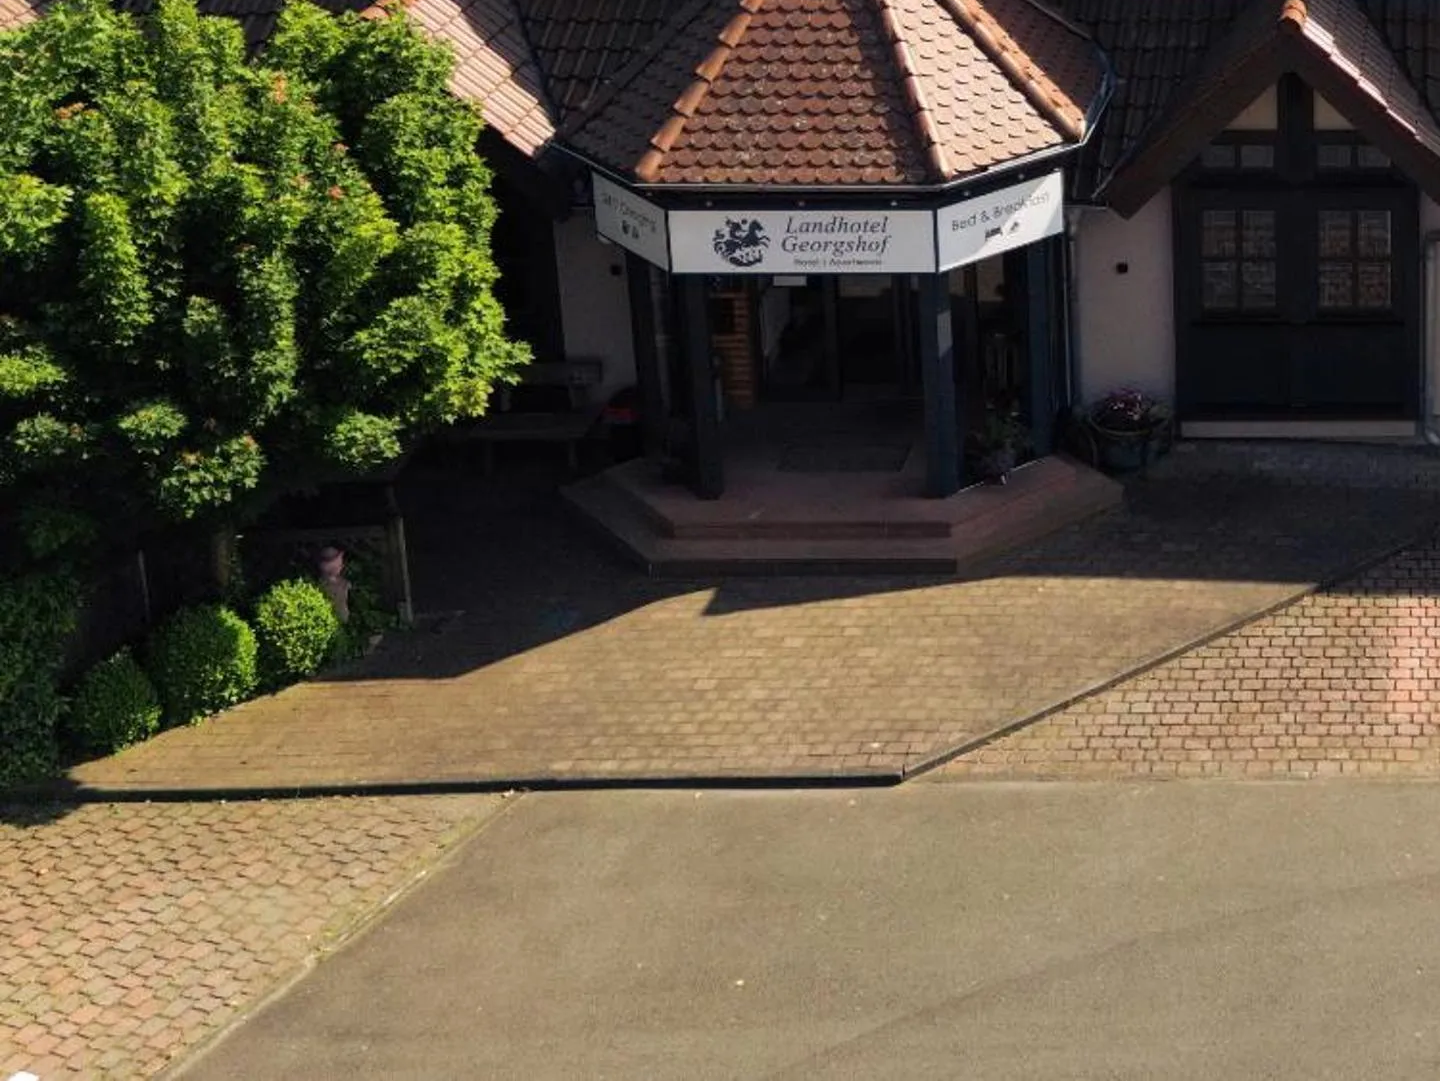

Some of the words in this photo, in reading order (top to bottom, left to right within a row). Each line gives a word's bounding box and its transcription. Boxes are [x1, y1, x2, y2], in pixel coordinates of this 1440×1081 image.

[952, 214, 976, 231] Bed
[994, 191, 1049, 218] Breakast
[786, 215, 889, 233] Landhotel
[781, 235, 892, 257] Georgshof
